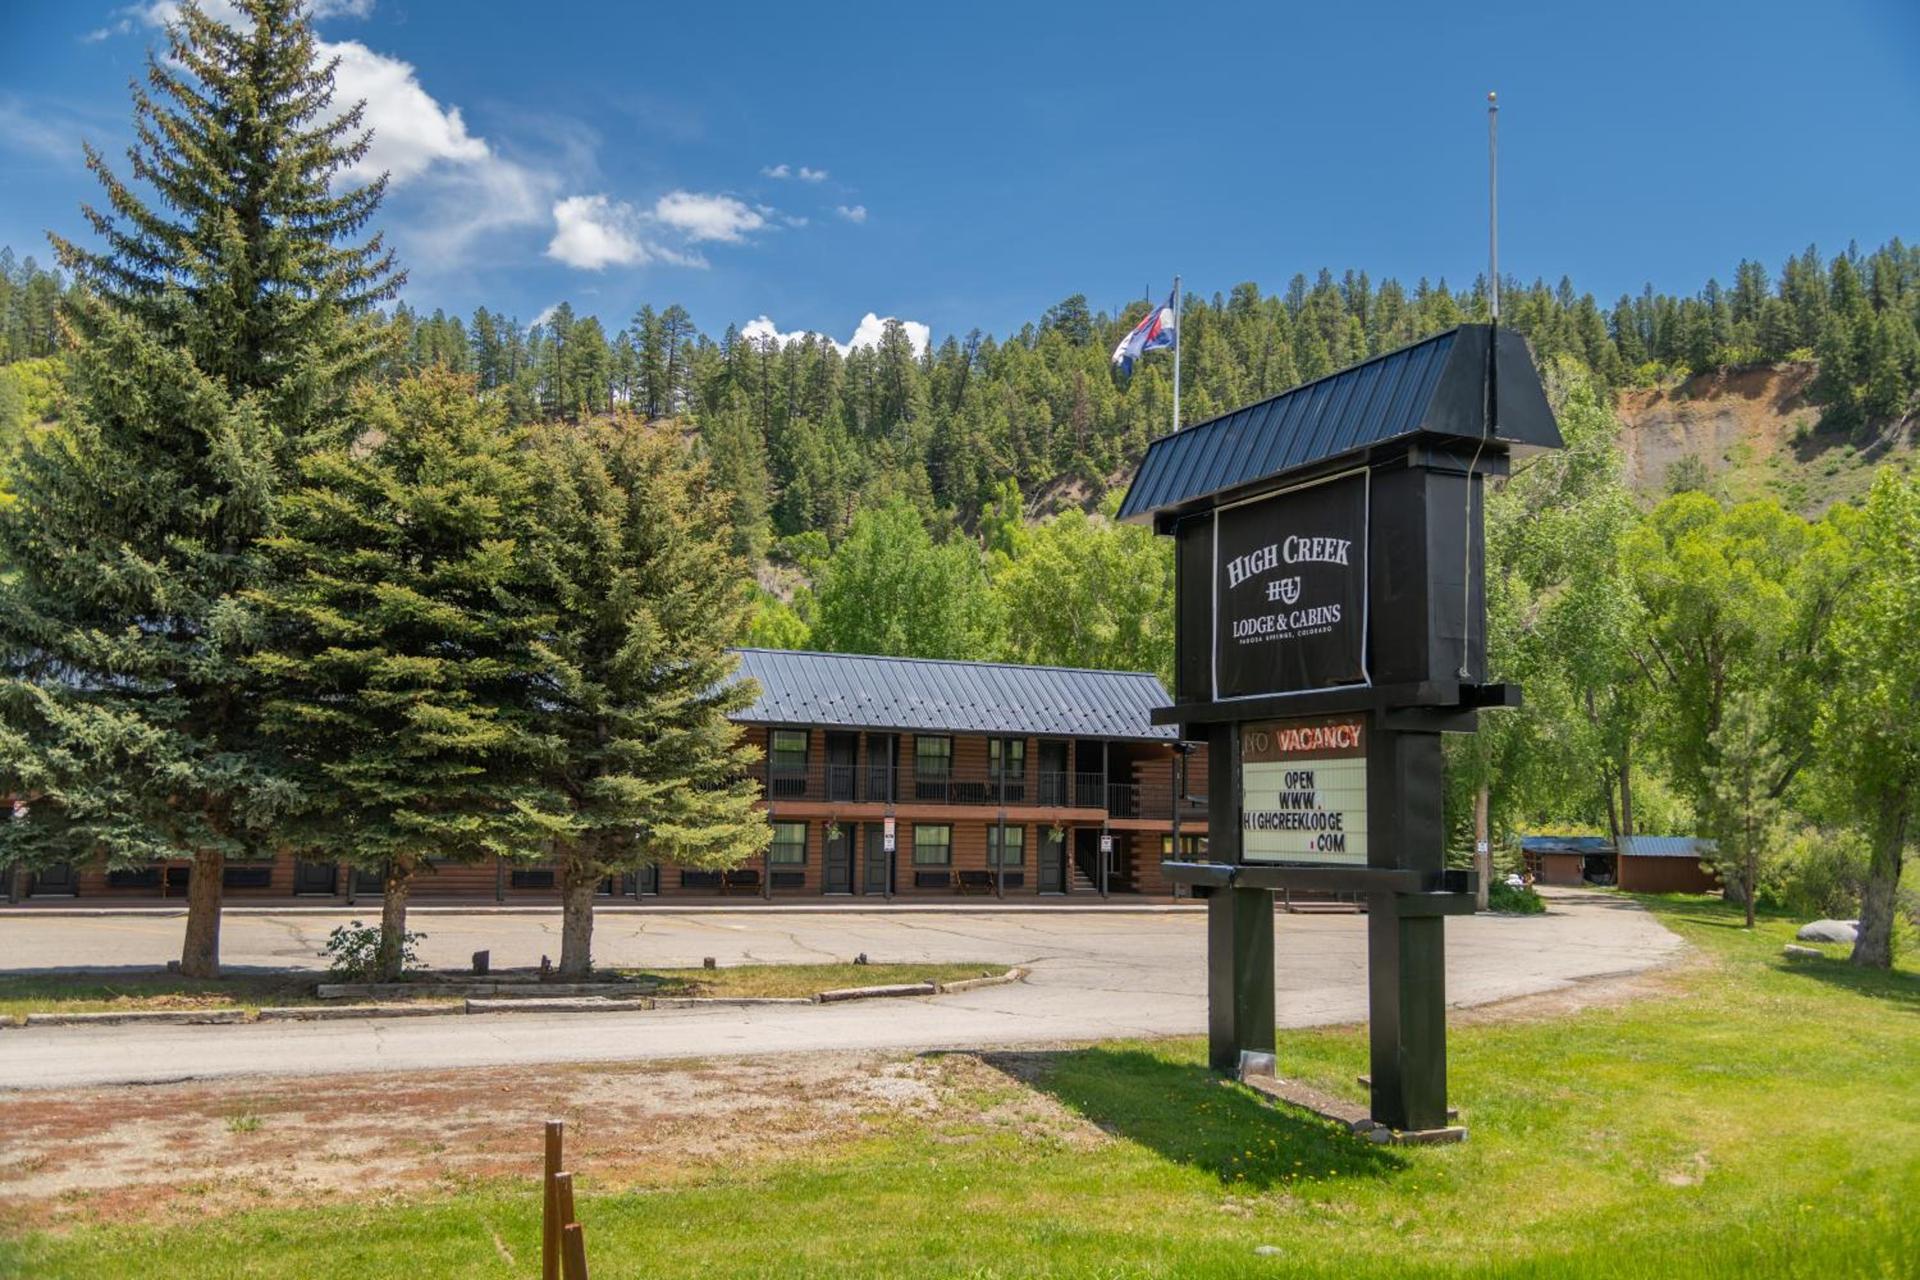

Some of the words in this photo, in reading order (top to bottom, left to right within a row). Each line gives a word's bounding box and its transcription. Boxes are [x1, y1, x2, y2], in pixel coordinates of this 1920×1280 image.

[1227, 544, 1278, 589] HIGH
[1283, 535, 1351, 566] CREEK
[1233, 615, 1275, 638] LODGE
[1290, 604, 1341, 629] CABINS
[1245, 732, 1268, 752] NO
[1277, 724, 1361, 751] VACANCY
[1285, 771, 1314, 789] OPEN
